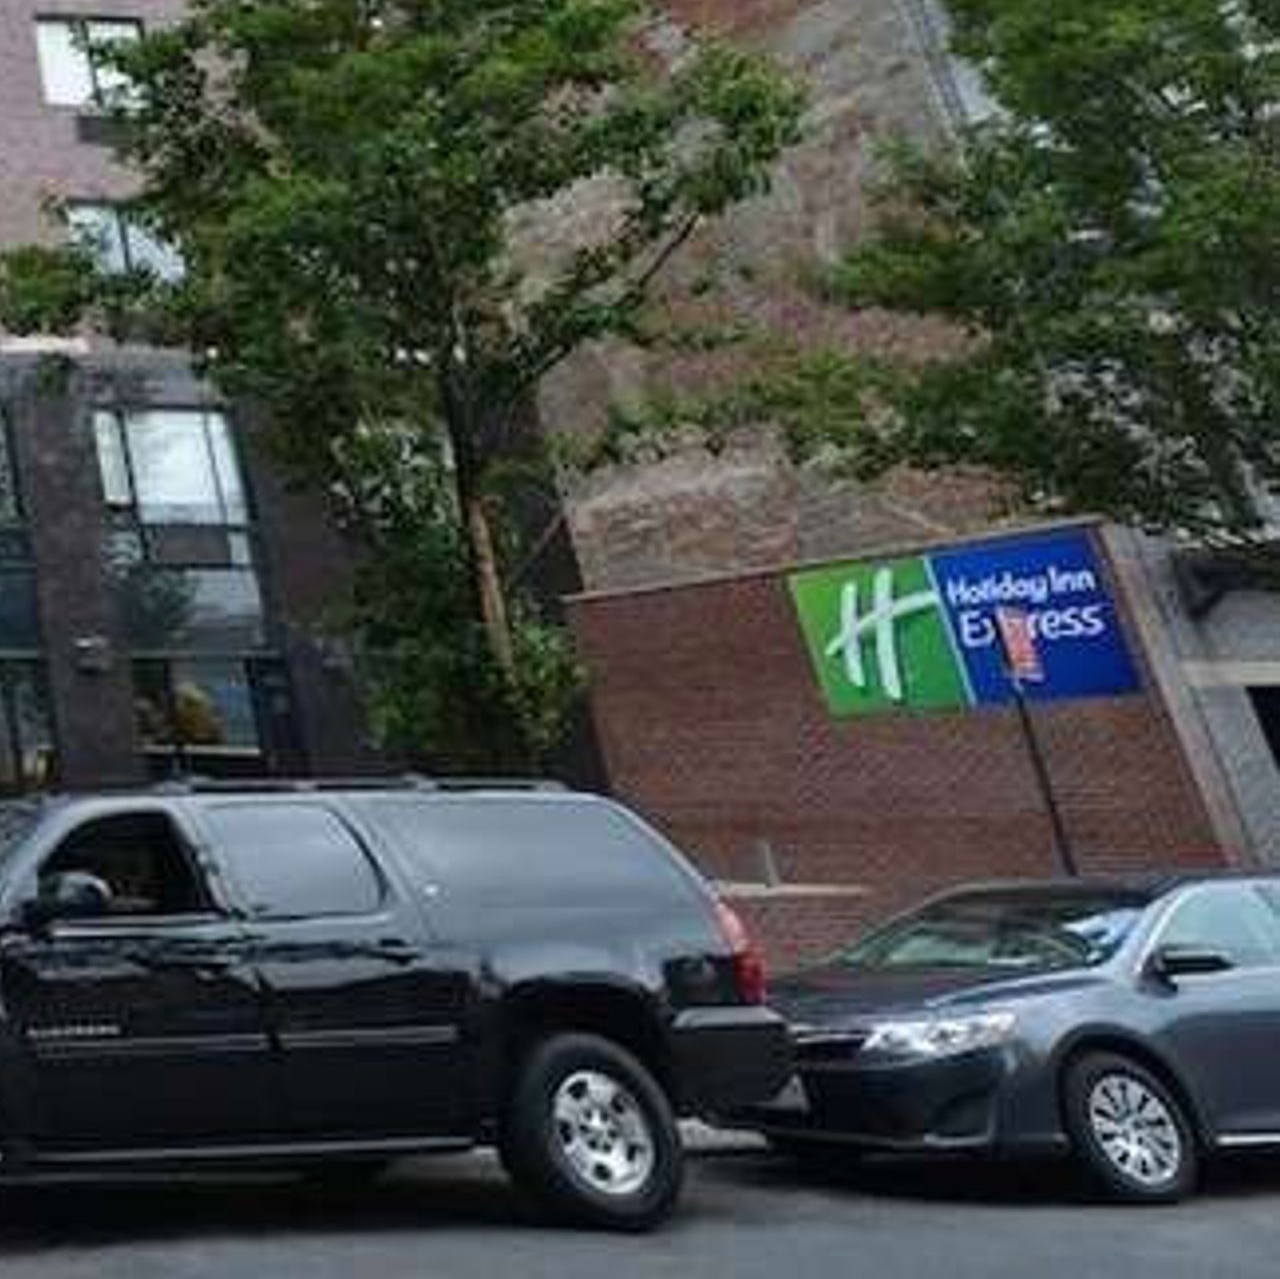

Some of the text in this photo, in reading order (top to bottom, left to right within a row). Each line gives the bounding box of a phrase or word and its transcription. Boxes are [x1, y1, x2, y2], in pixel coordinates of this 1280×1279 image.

[947, 566, 1096, 606] Holiday Inn
[960, 605, 1105, 648] Exress
